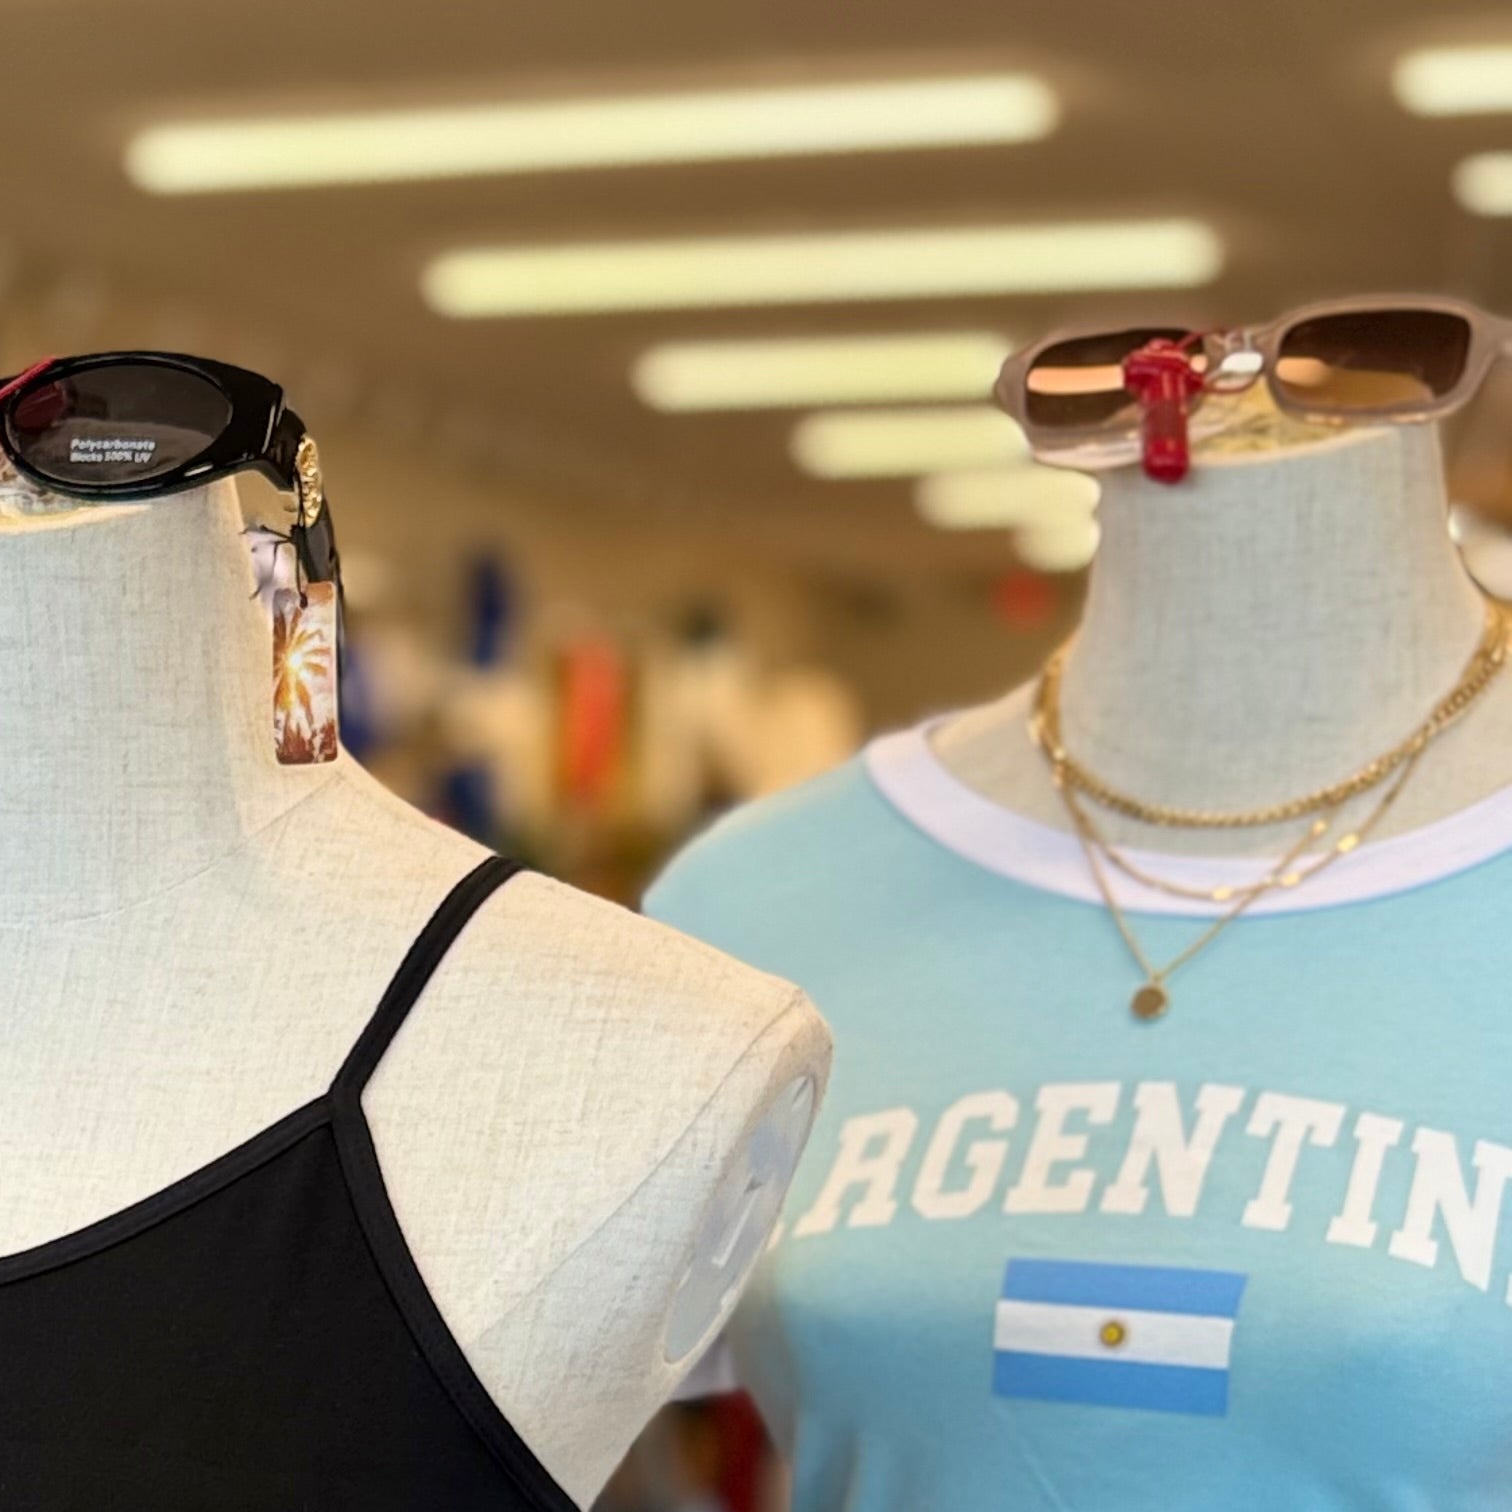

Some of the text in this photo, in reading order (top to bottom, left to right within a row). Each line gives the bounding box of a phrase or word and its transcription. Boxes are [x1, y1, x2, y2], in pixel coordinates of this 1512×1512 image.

[70, 438, 156, 451] Polycarbonate
[134, 451, 153, 463] UV
[765, 1081, 1512, 1308] RGENTIN
